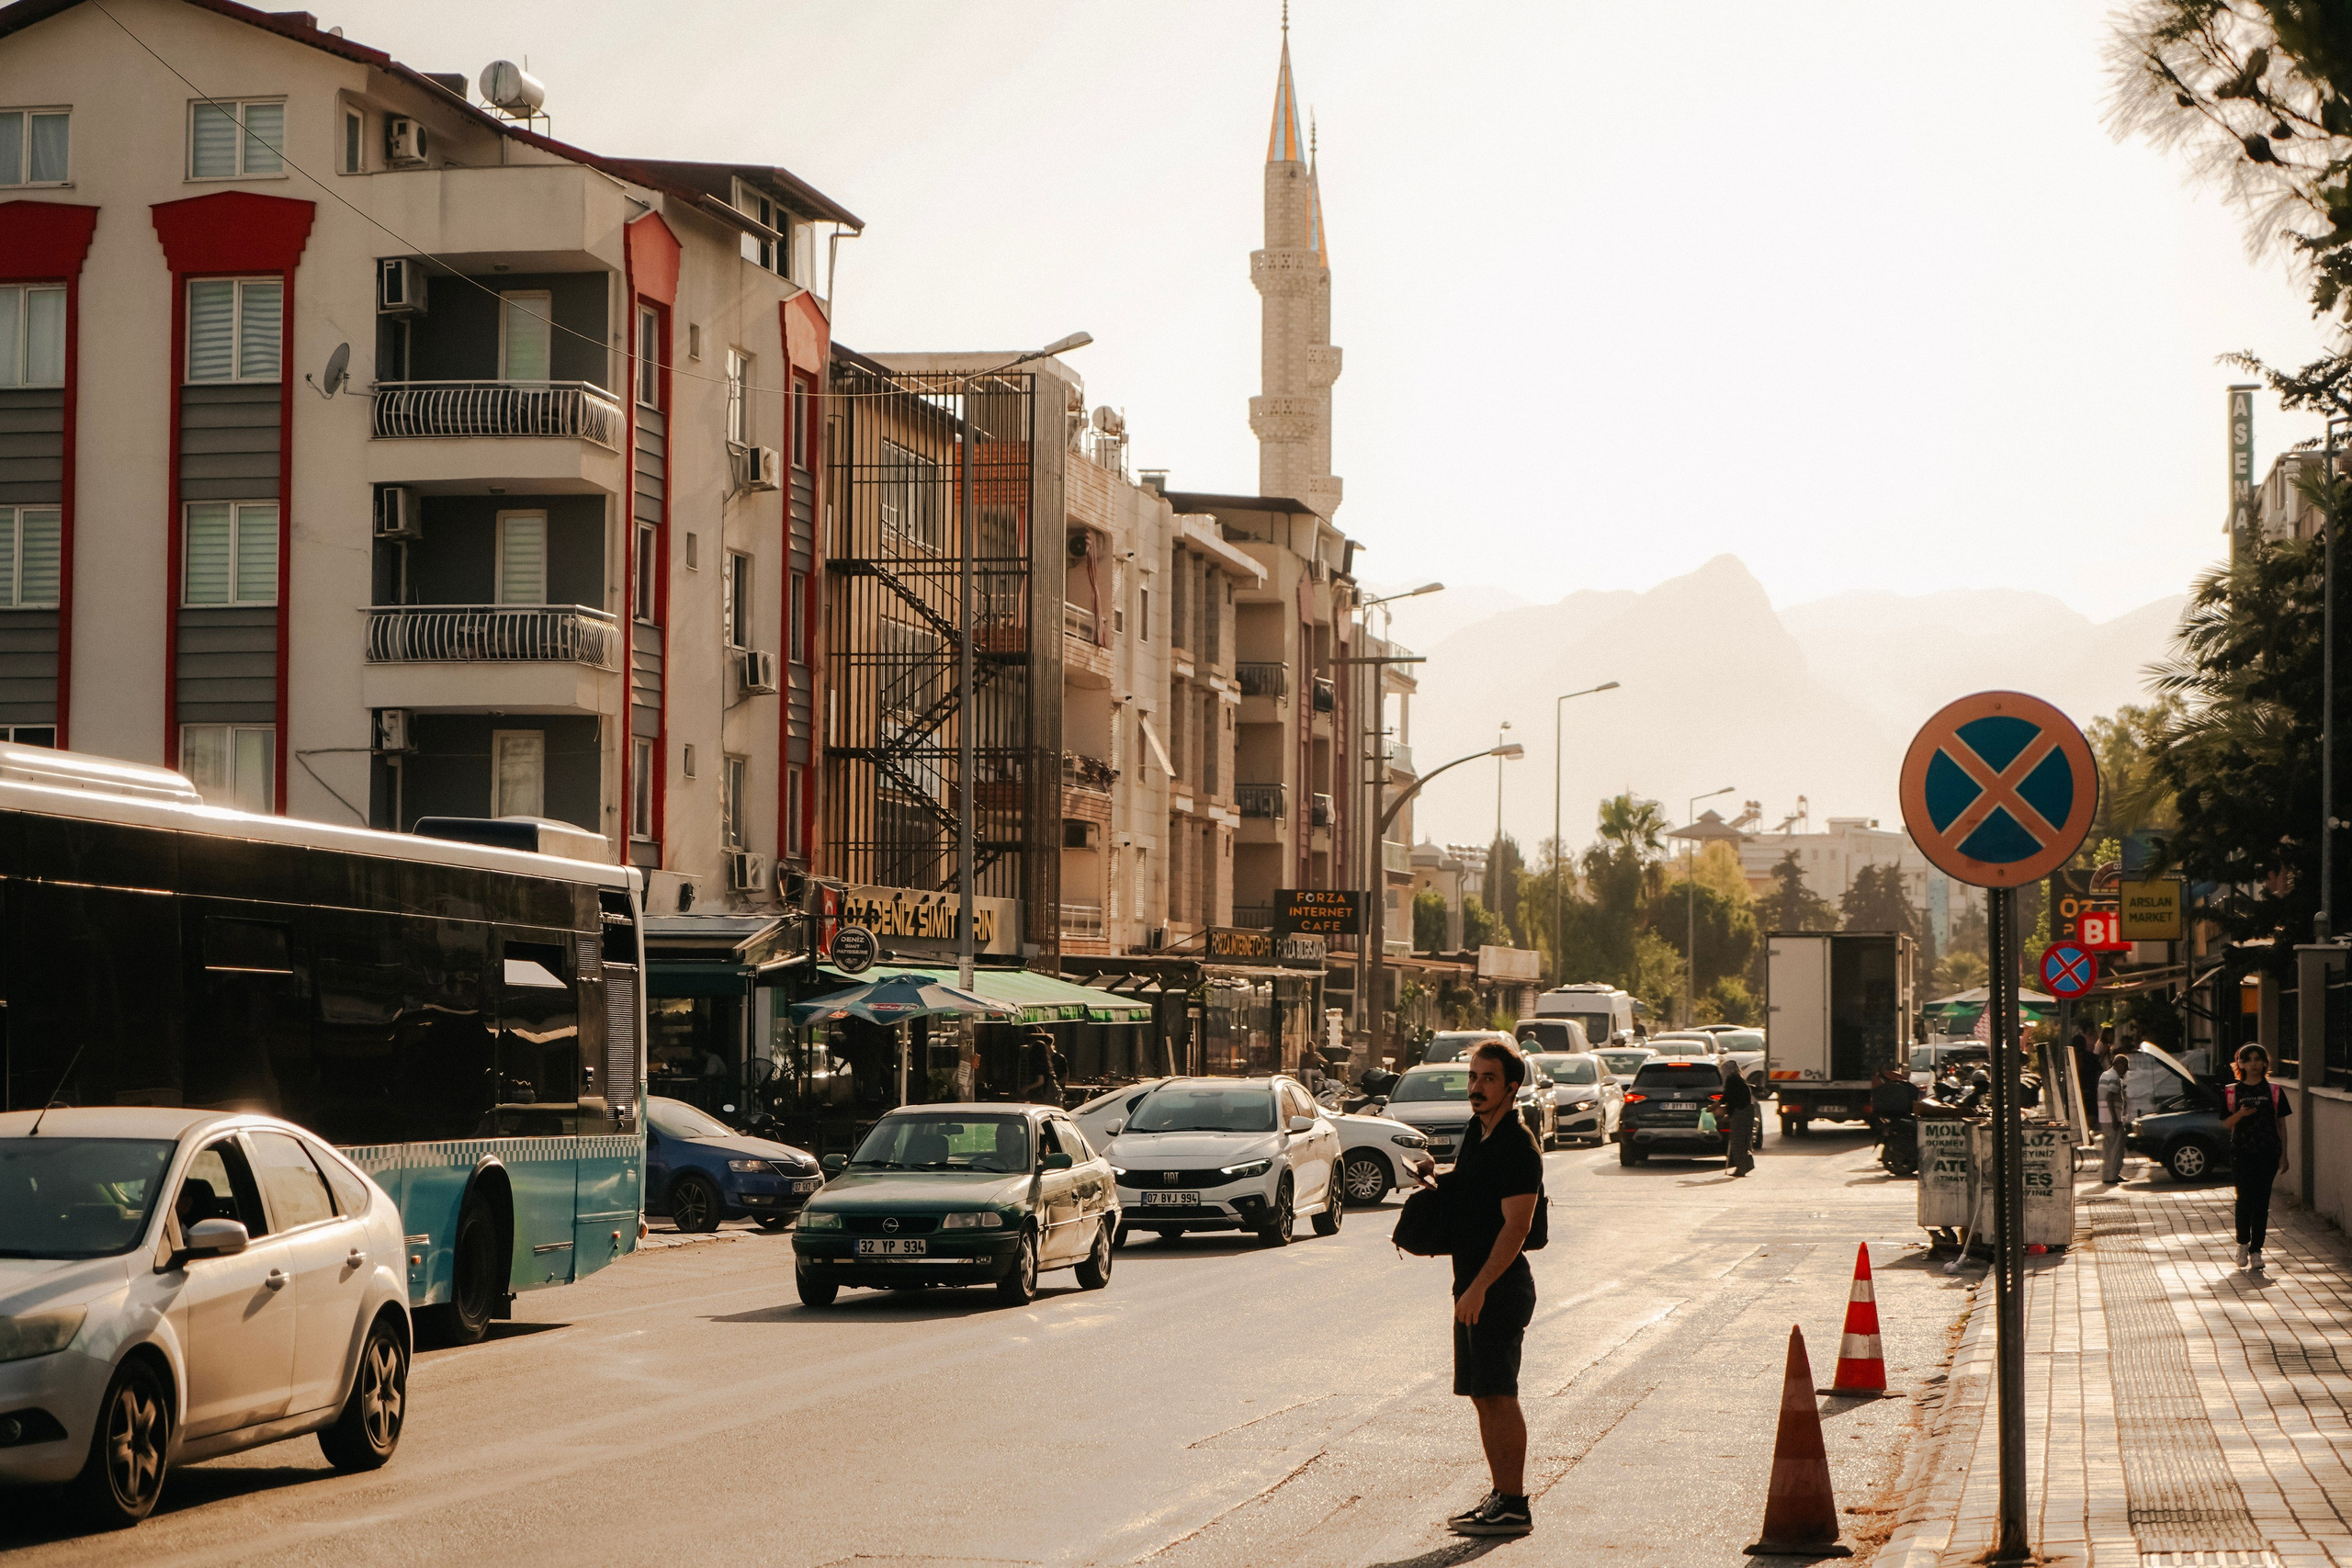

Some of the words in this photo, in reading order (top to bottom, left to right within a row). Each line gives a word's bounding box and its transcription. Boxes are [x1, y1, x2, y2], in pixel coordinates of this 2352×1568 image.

[2233, 395, 2249, 530] ASENA
[1296, 892, 1346, 903] FORZA
[2129, 897, 2173, 908] ARSLAN
[1289, 907, 1353, 918] INTERNET
[2129, 911, 2173, 923] MARKET
[972, 907, 994, 941] RIN
[1301, 920, 1340, 931] CAFE
[2084, 912, 2117, 944] Bİ
[1934, 1160, 1966, 1172] ATE
[1163, 1171, 1180, 1184] FIAT
[1148, 1194, 1158, 1203] 07
[1161, 1194, 1177, 1203] BVJ
[1181, 1194, 1197, 1203] 994
[861, 1241, 874, 1253] 32
[882, 1241, 896, 1253] YP
[903, 1241, 924, 1253] 934
